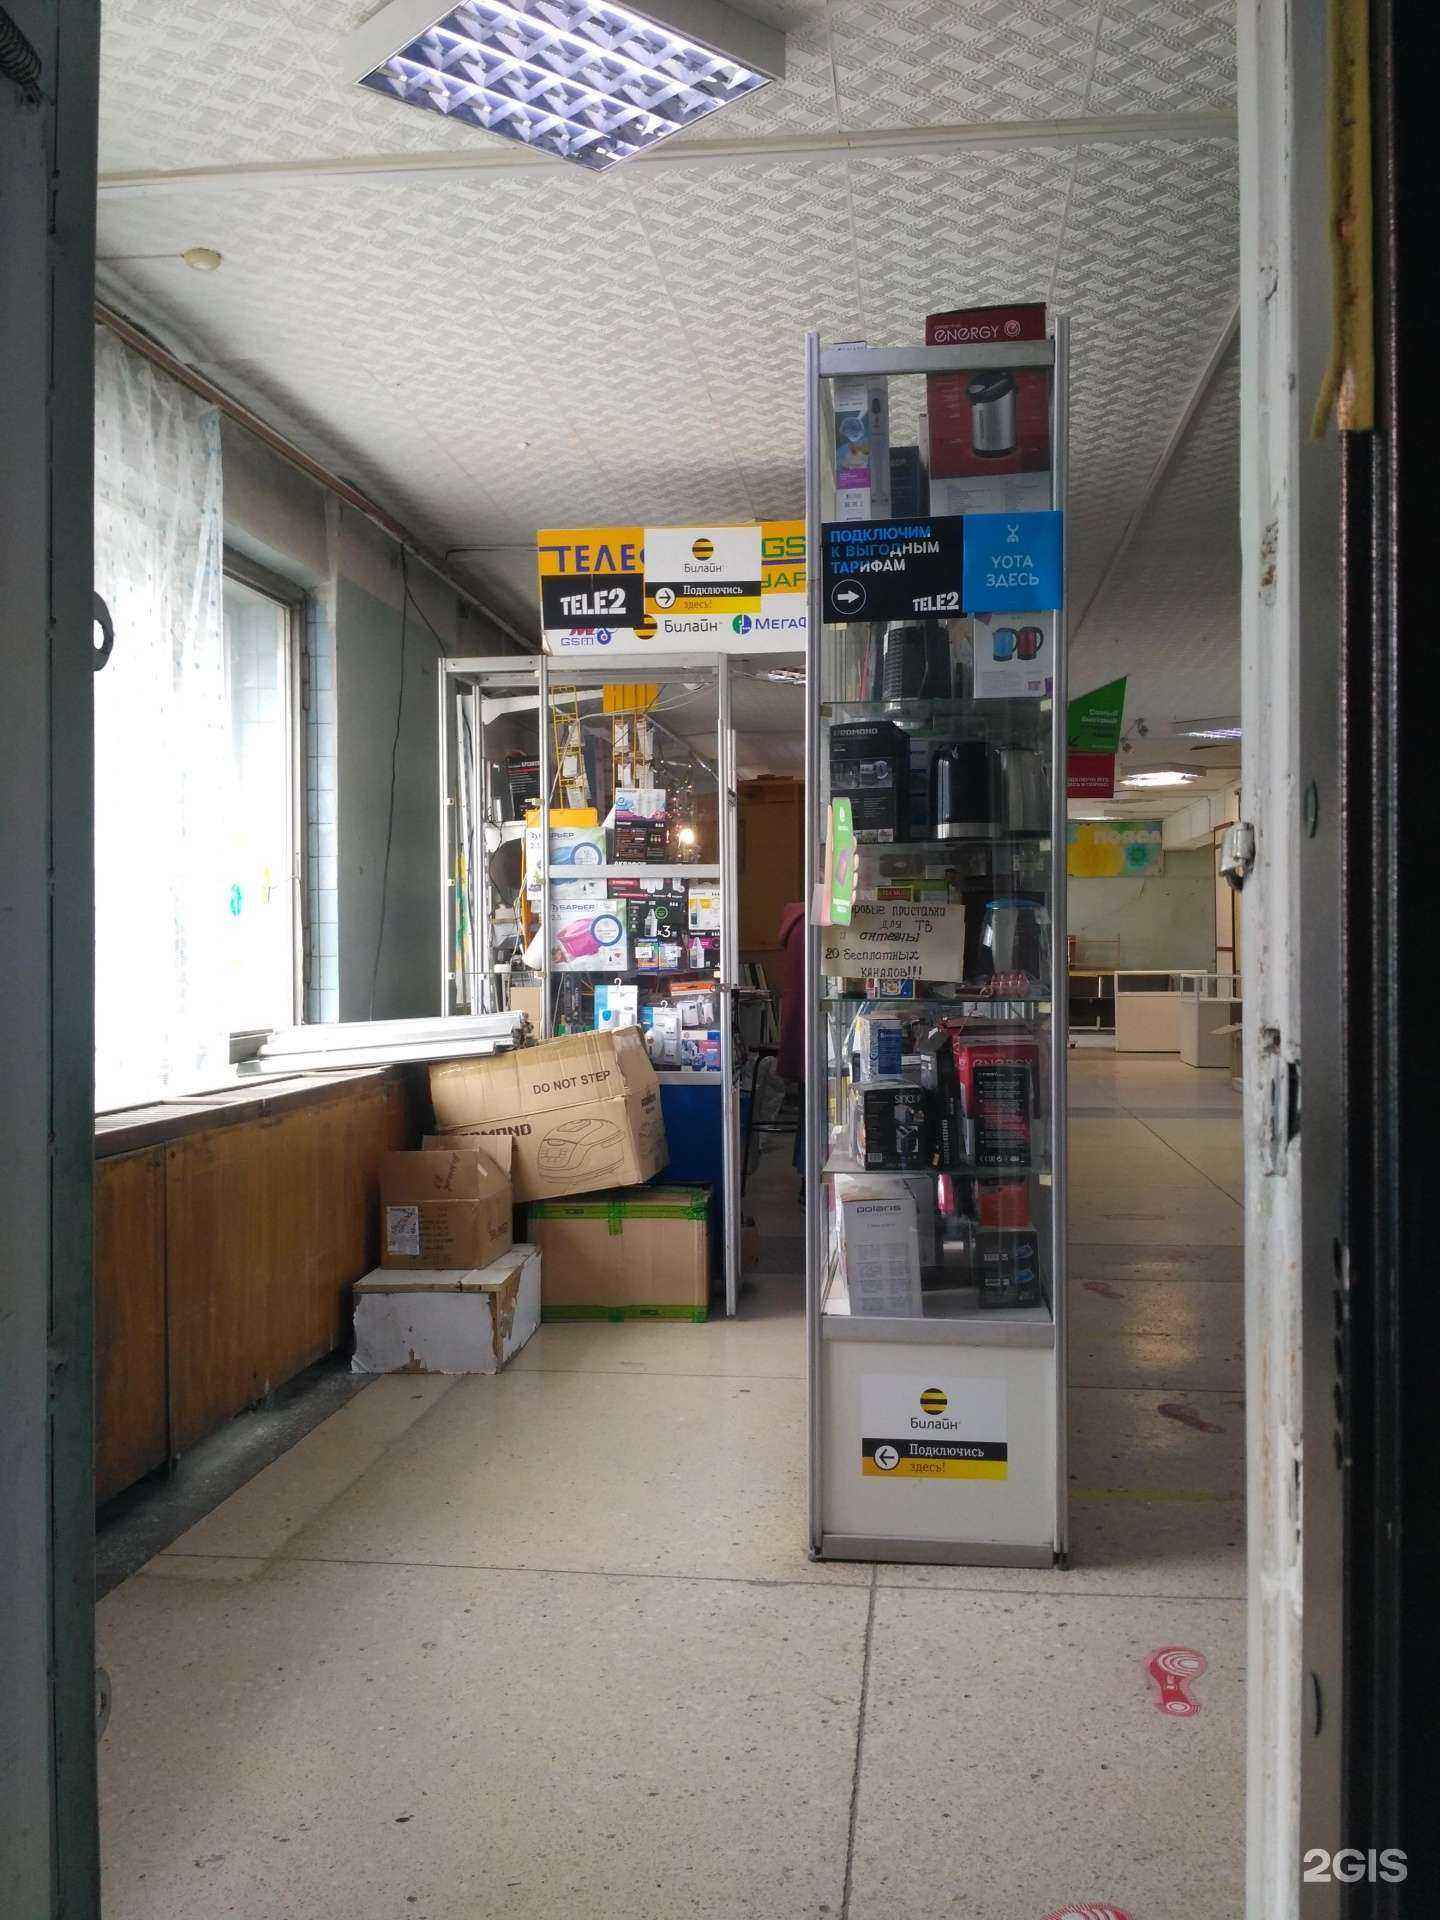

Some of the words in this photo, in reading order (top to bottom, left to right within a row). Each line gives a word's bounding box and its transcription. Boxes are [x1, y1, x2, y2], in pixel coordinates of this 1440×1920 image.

[830, 526, 931, 543] ПОДКЛЮЧИМ
[832, 546, 841, 558] К
[846, 541, 939, 558] ВЫГОДНЫМ
[684, 562, 722, 574] Билайн
[830, 559, 906, 574] ТАРИФАМ
[991, 554, 1034, 569] YOTA
[986, 572, 1040, 588] ЗДЕСЬ
[683, 585, 744, 596] Подключись
[560, 587, 627, 616] TELE2
[912, 591, 960, 612] TELE2
[664, 618, 718, 633] Билайн
[825, 947, 840, 960] 20
[533, 1083, 550, 1095] DO
[553, 1077, 577, 1090] NOT
[581, 1070, 611, 1085] STEP
[856, 1204, 902, 1214] polaris
[910, 1417, 958, 1430] Билайн
[909, 1443, 985, 1458] Подключись
[910, 1462, 946, 1473] здесь!
